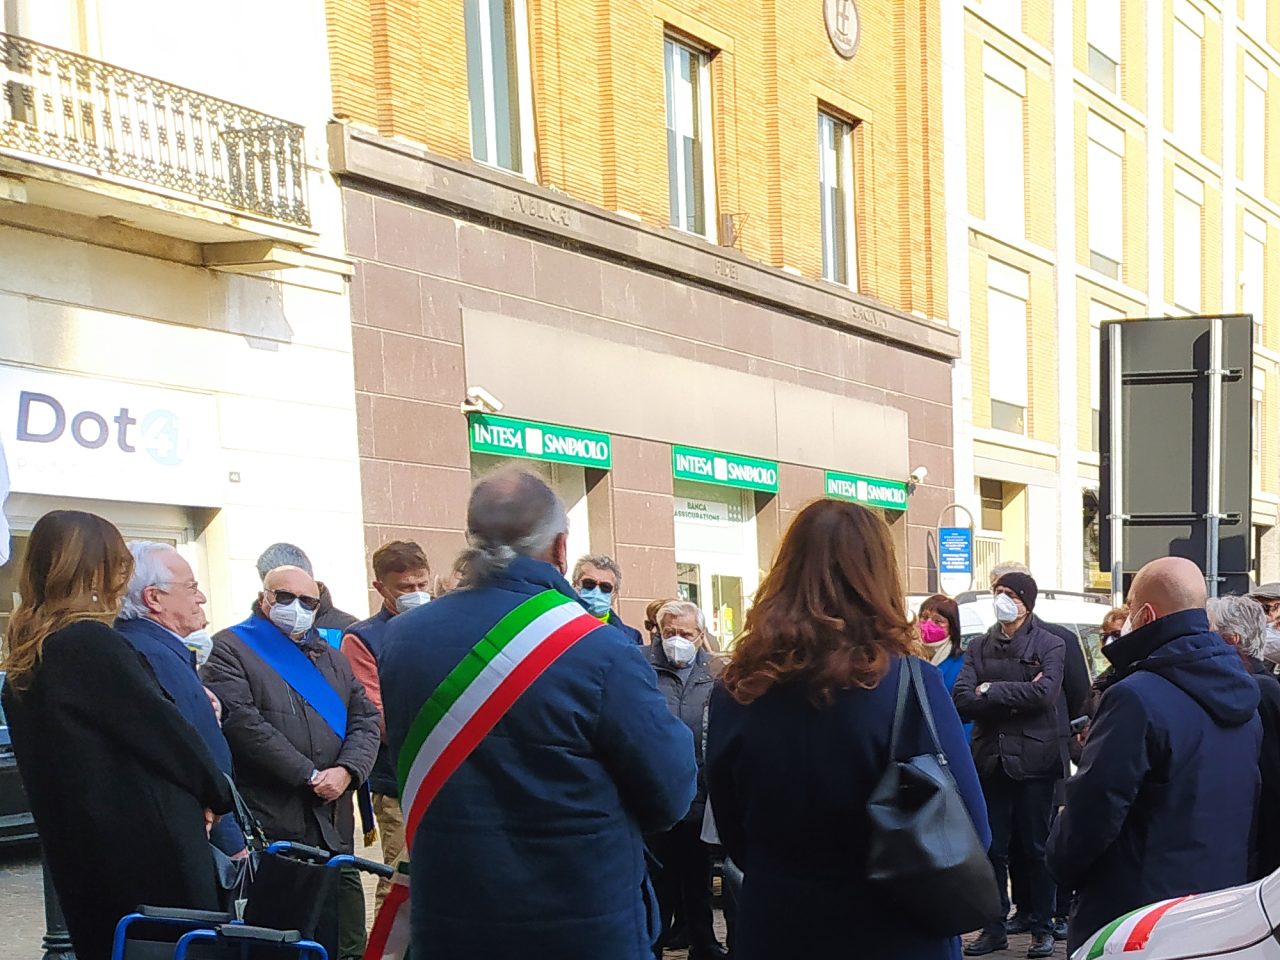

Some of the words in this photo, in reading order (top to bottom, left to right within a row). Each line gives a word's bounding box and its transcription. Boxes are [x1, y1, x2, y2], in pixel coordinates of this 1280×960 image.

[474, 422, 524, 450] INTESA
[544, 433, 609, 461] SANPAOLO
[676, 453, 713, 477] INTESA
[728, 462, 777, 486] SANPAOLO
[827, 478, 857, 498] INTESA
[867, 484, 906, 504] SANPAOLO
